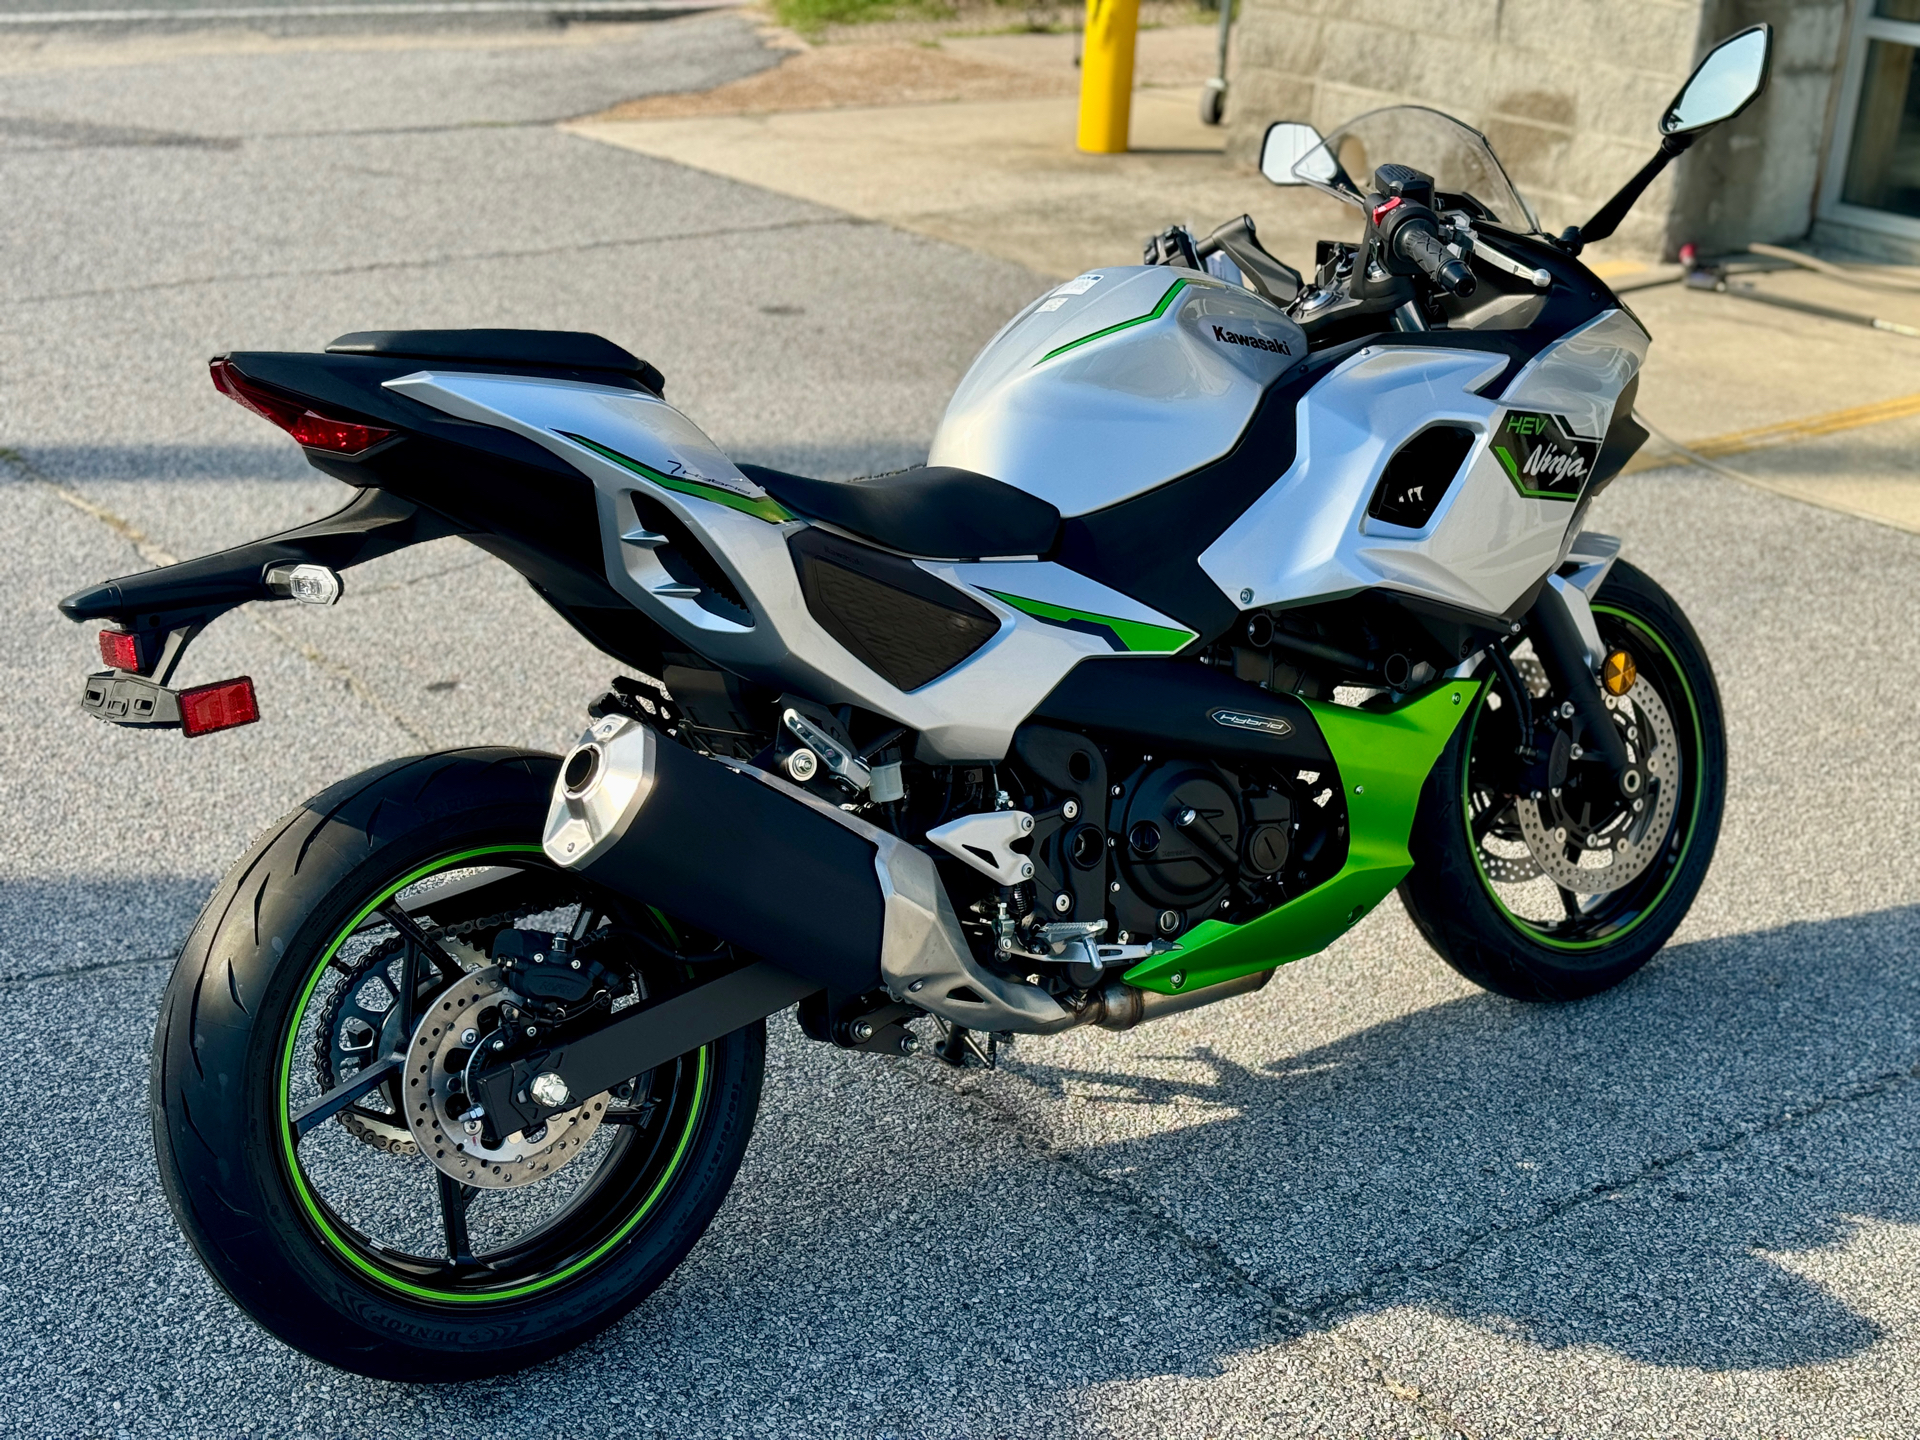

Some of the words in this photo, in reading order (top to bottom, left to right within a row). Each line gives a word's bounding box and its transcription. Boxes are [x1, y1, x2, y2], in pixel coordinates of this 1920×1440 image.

[1212, 325, 1292, 356] Kawasaki
[1506, 416, 1548, 435] HEV
[1523, 442, 1588, 486] Ninja
[1220, 714, 1284, 730] Hybrid
[371, 1314, 462, 1342] DUNLOP
